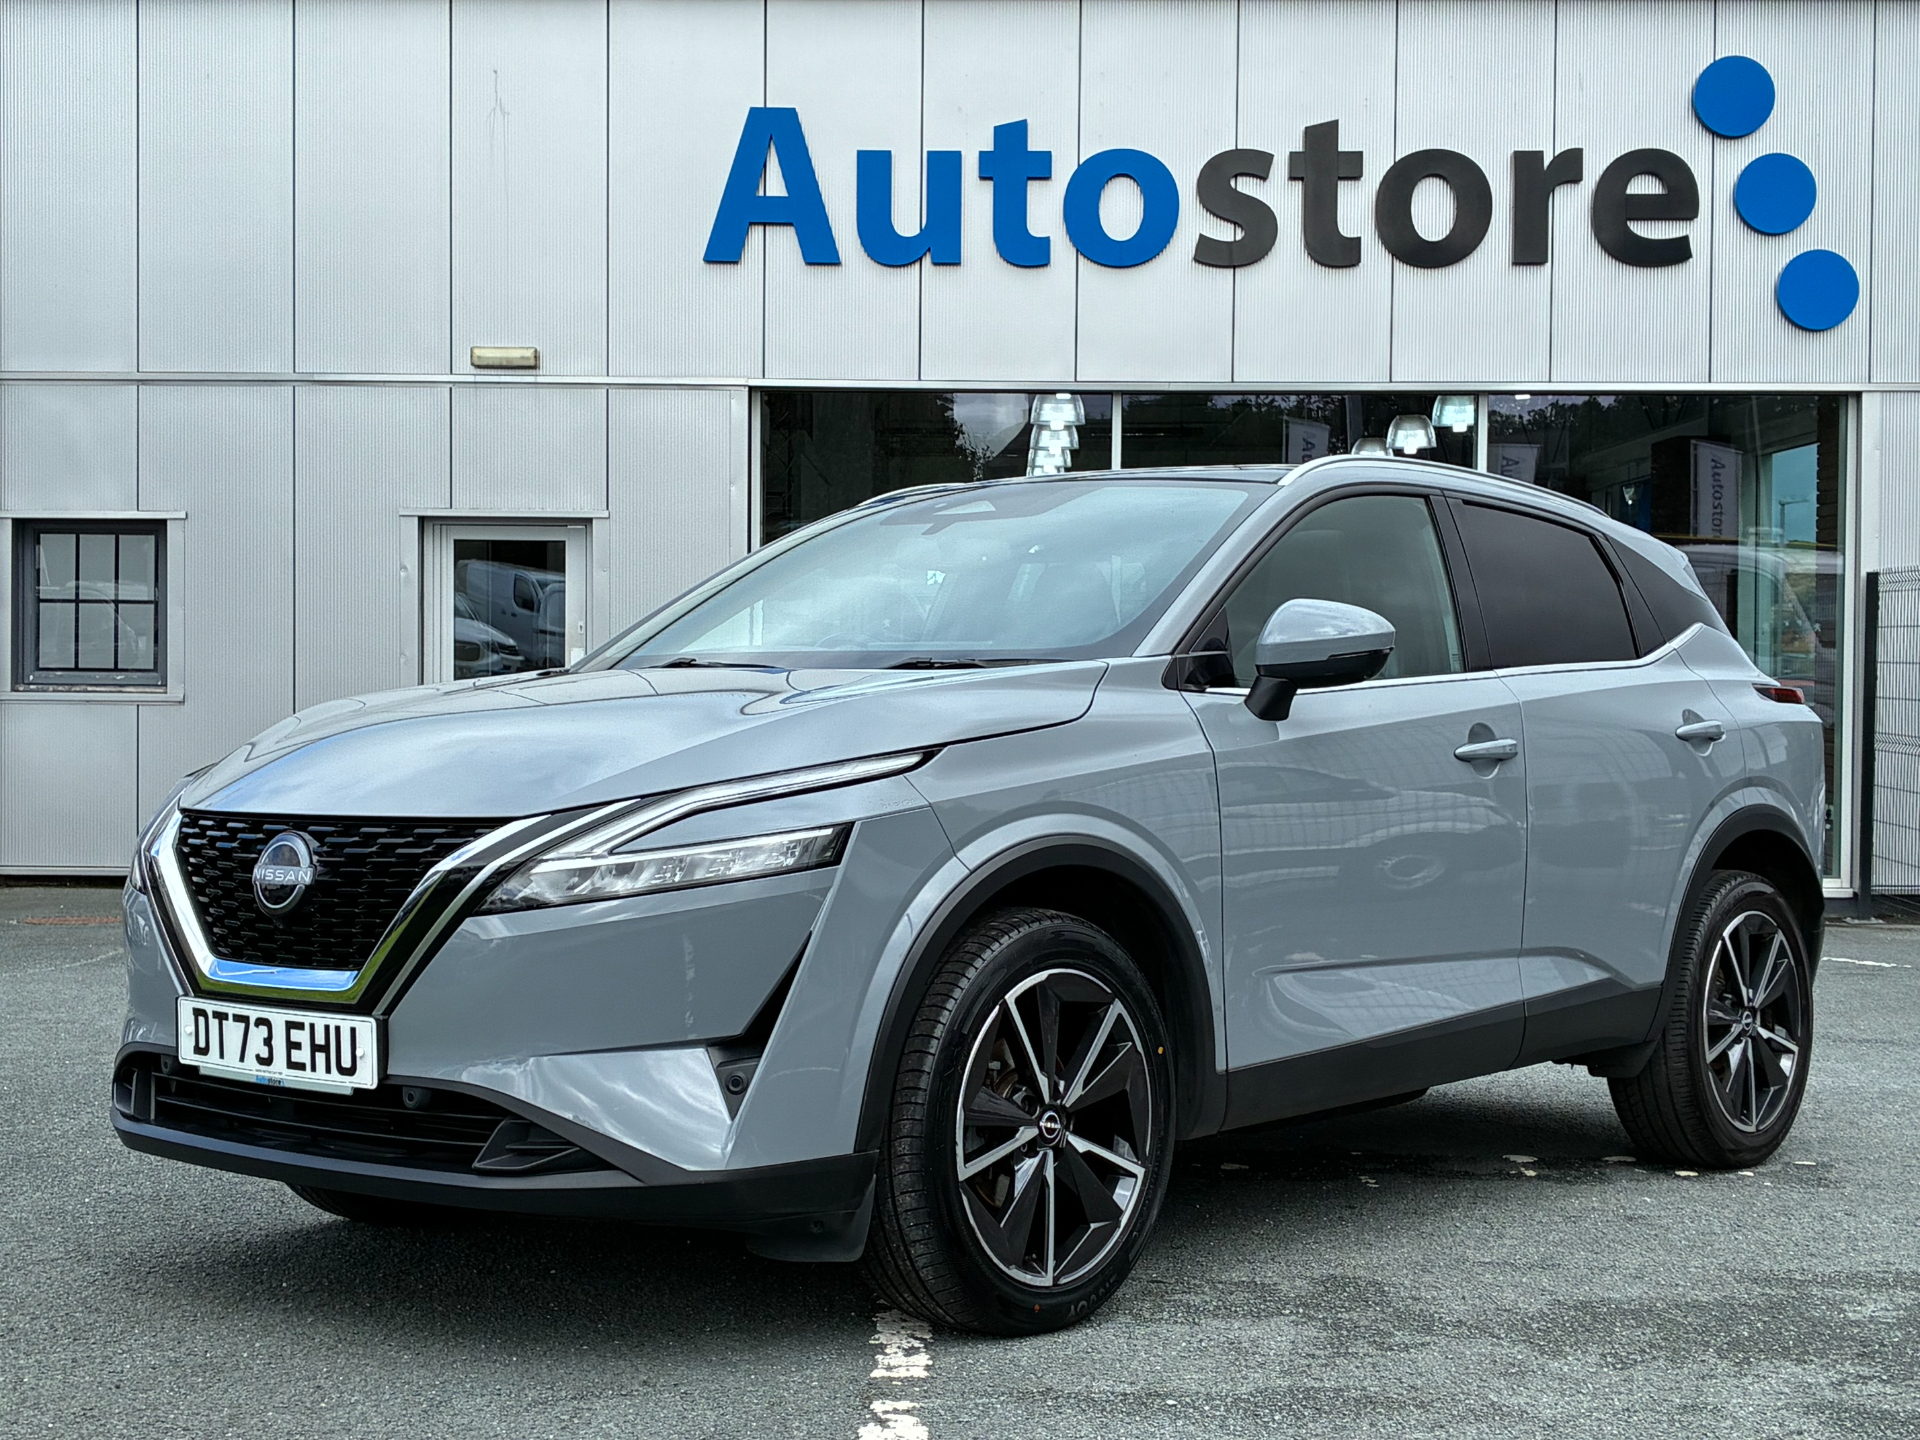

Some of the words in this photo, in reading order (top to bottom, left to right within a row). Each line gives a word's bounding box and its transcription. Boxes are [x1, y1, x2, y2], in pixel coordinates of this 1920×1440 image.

[704, 106, 1700, 268] Autostore
[1711, 458, 1726, 537] Autostor
[254, 868, 311, 882] NISSAN
[192, 1007, 274, 1067] DT73
[285, 1020, 357, 1076] EHU
